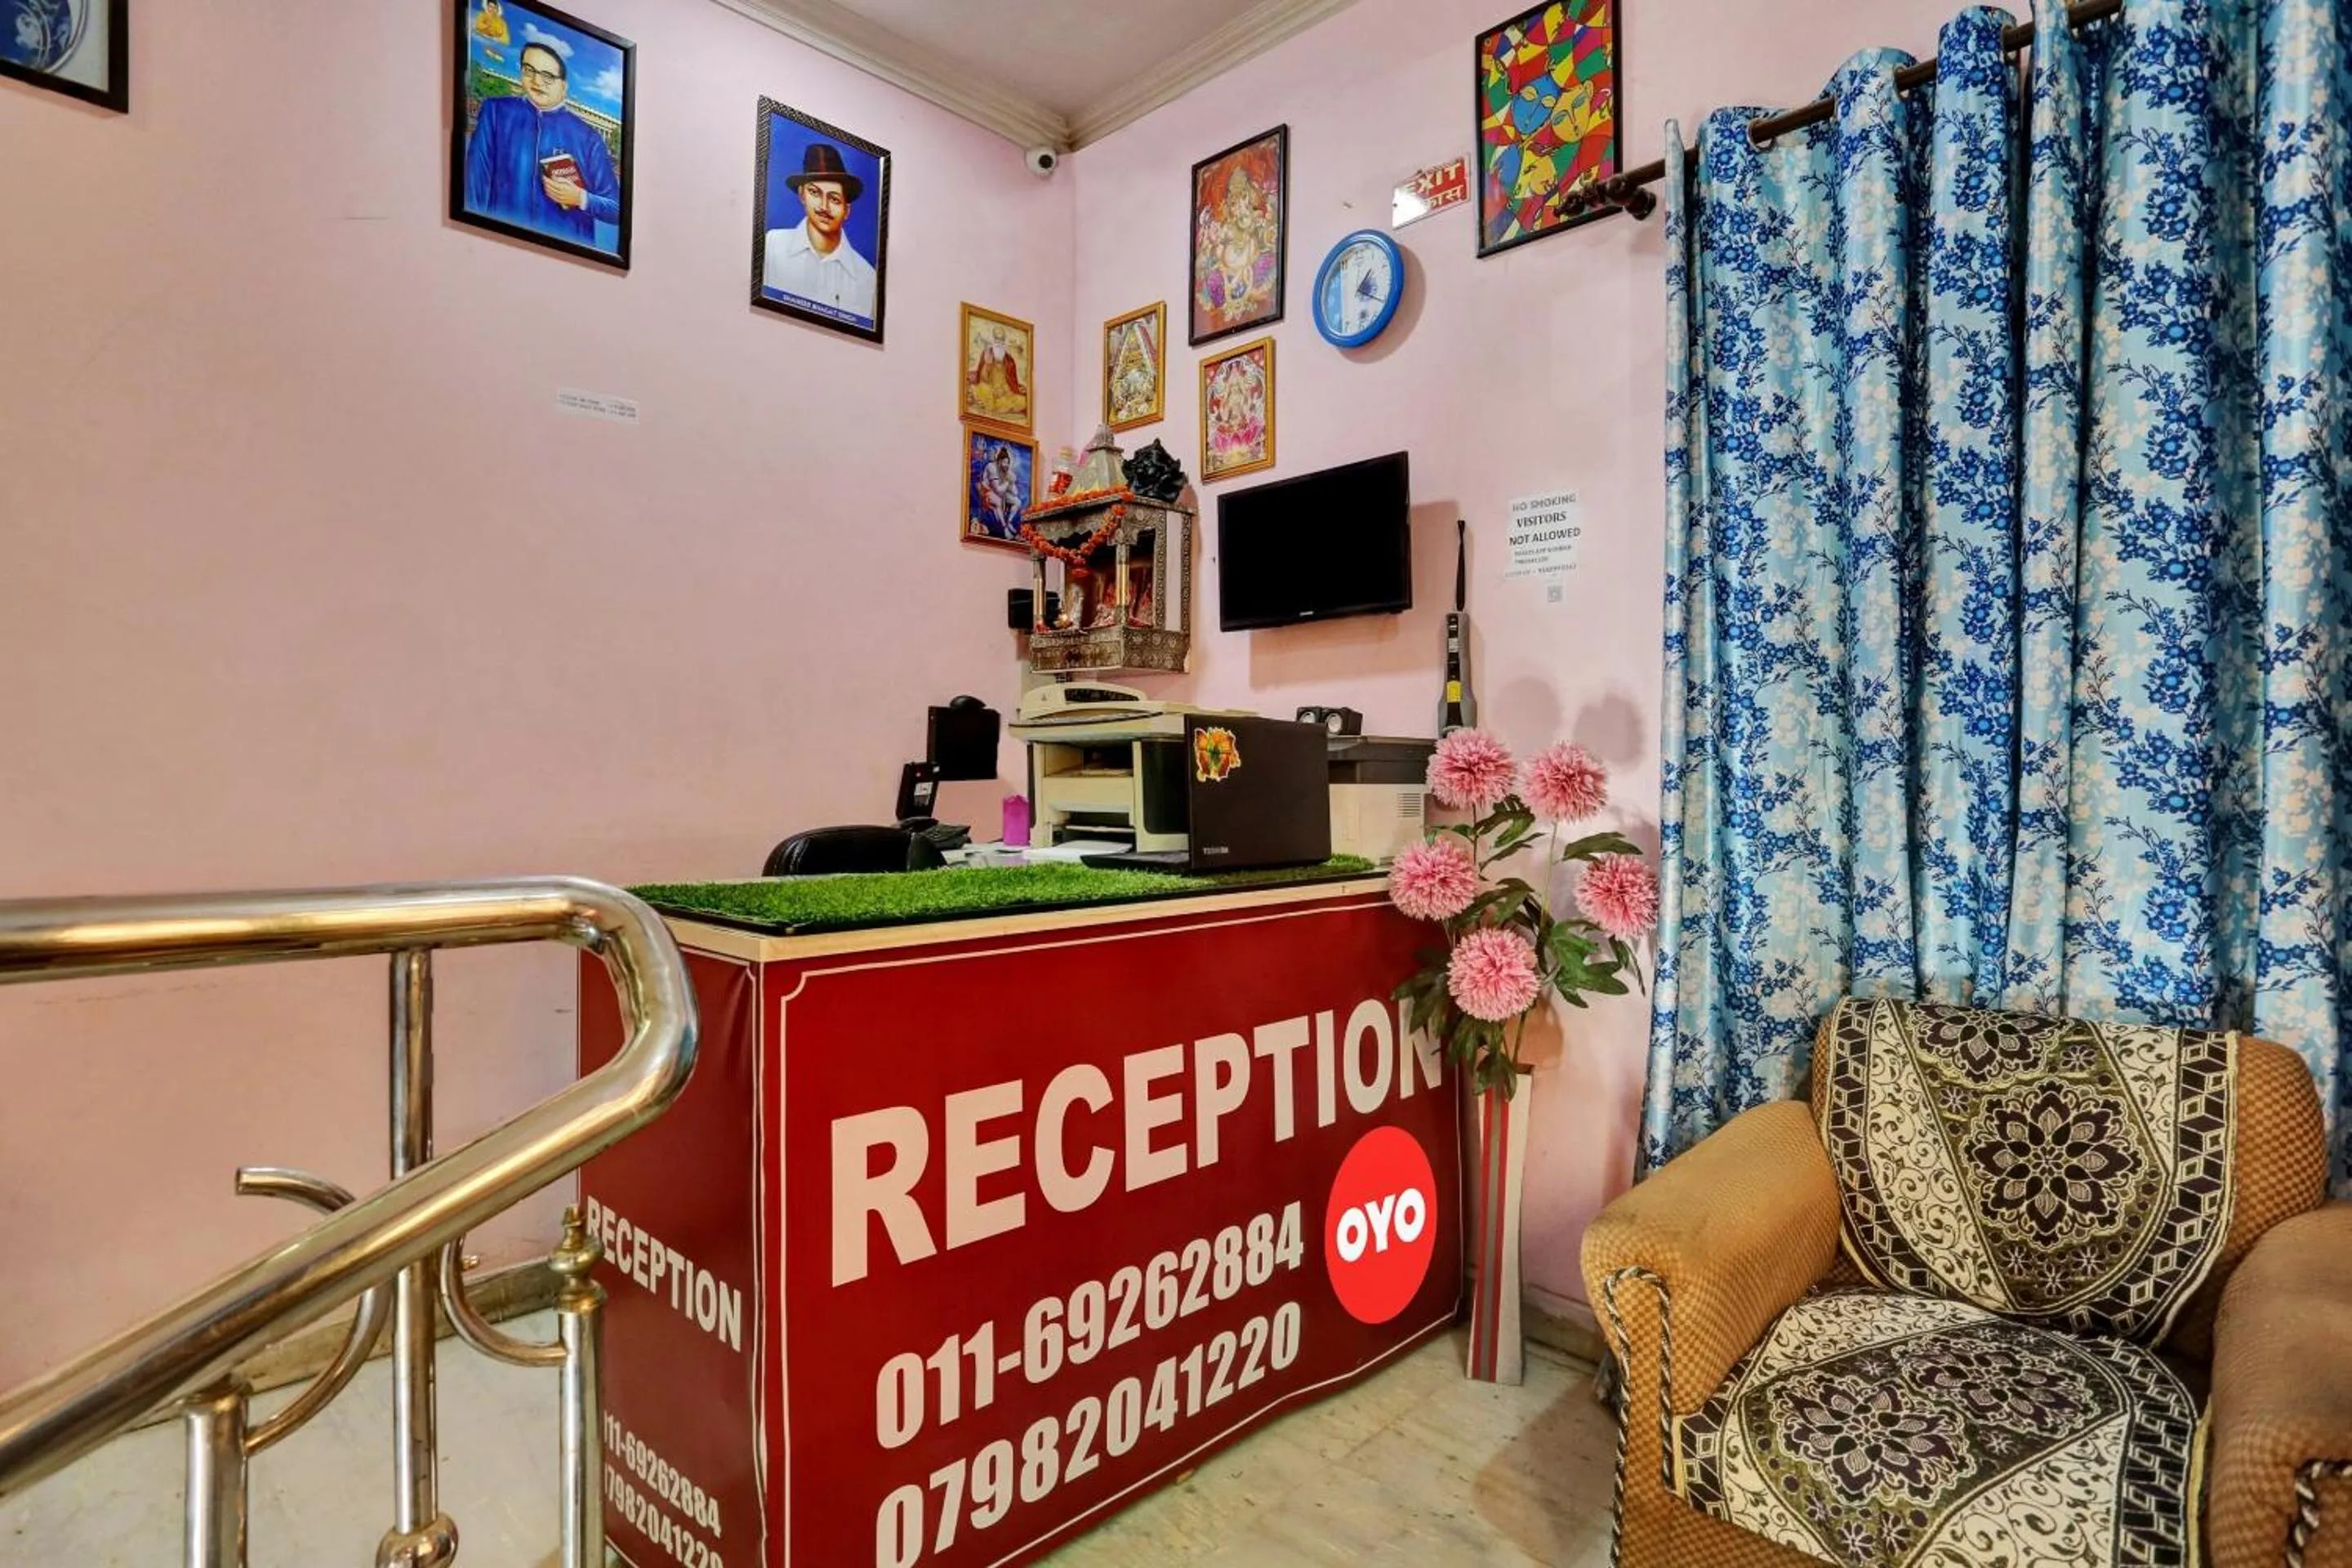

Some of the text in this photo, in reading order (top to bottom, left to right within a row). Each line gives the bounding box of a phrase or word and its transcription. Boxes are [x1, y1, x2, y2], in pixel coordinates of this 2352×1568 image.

[1404, 162, 1462, 195] EXIT
[1509, 527, 1581, 546] NOT ALLOWED
[1512, 493, 1576, 512] NO SMOKING
[1517, 511, 1567, 528] VISITORS
[831, 999, 1442, 1288] RECEPTION
[586, 1195, 742, 1353] RECEPTION
[1336, 1187, 1426, 1263] OYO
[876, 1200, 1303, 1450] 011-69262884
[604, 1410, 721, 1539] 11-69262884
[876, 1301, 1301, 1568] 07982041220
[604, 1462, 724, 1568] 798204122
